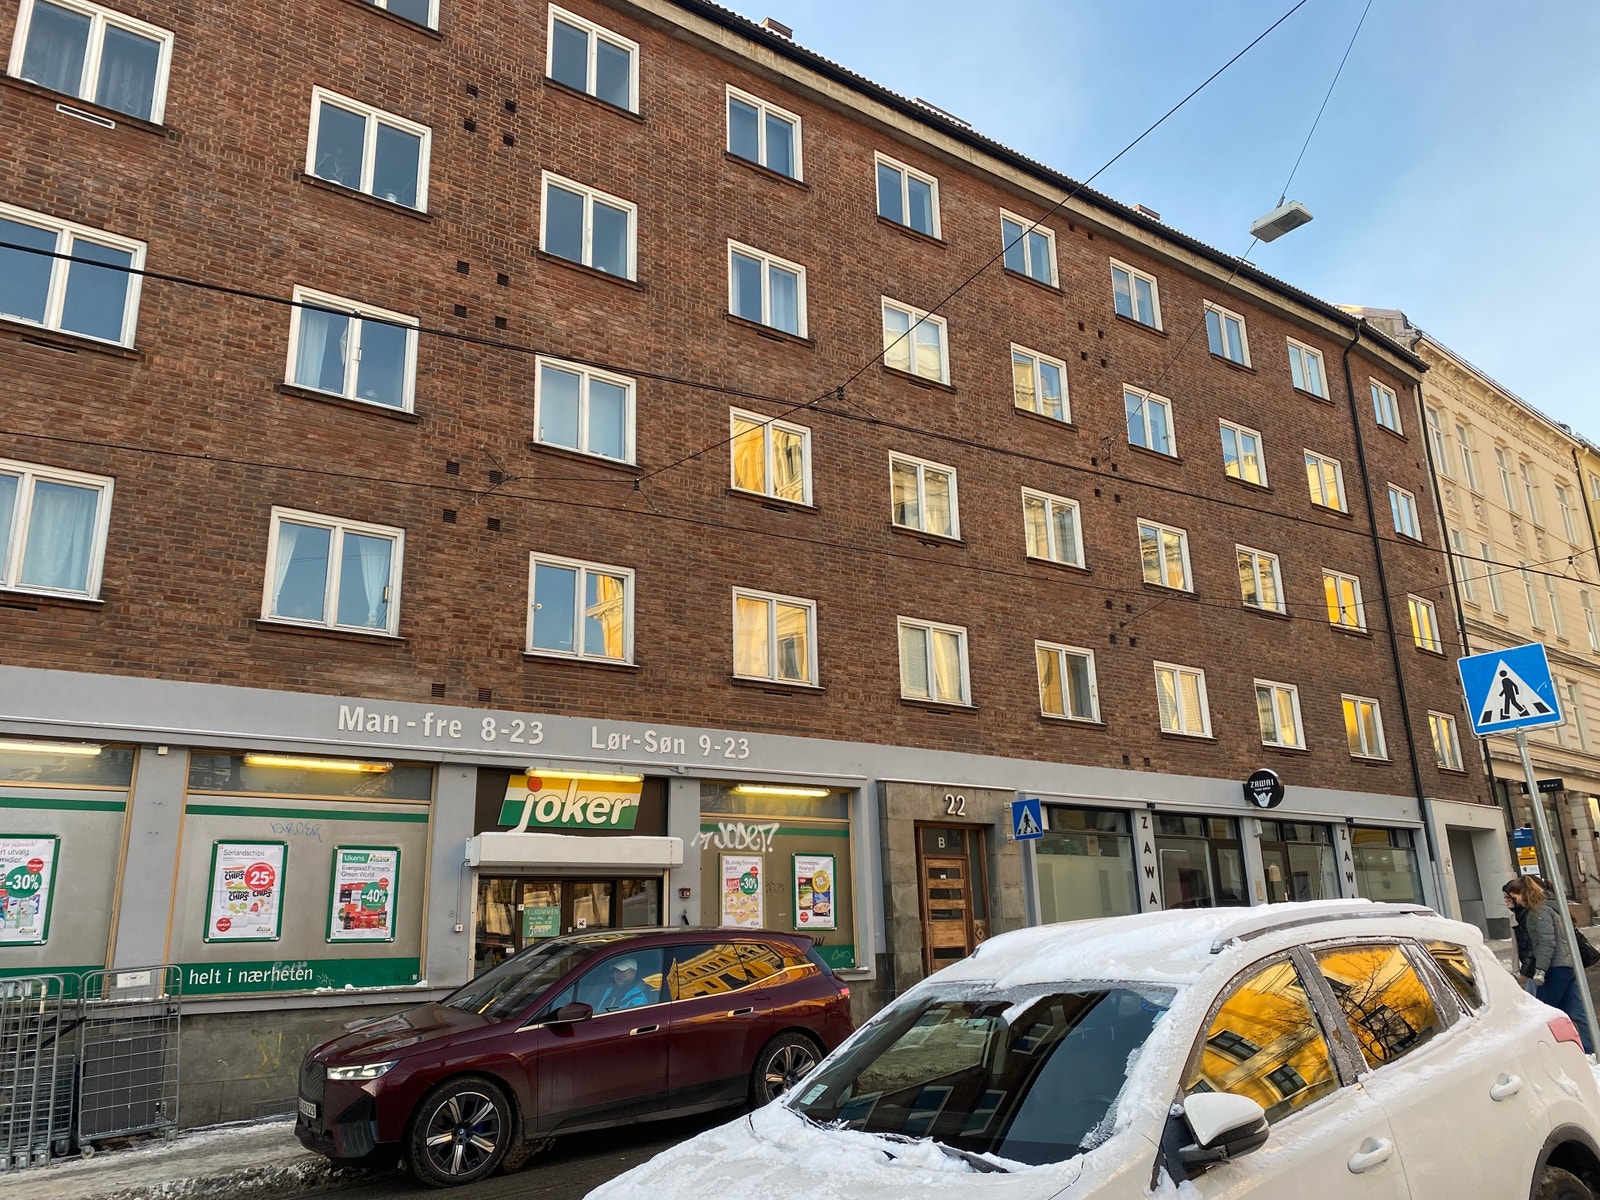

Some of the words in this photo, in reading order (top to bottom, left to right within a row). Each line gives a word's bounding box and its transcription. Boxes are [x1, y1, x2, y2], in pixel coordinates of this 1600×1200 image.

[480, 717, 544, 745] 8-23
[591, 726, 685, 755] Lør-Søn
[698, 734, 750, 760] 9-23
[507, 777, 632, 833] joker
[945, 793, 966, 817] 22
[938, 836, 946, 848] B
[223, 849, 265, 857] Sørlandschips
[344, 854, 365, 862] Ukens
[5, 874, 39, 890] -30%
[224, 872, 244, 880] CHIPS
[249, 871, 269, 885] 25
[228, 893, 249, 901] CHIPS
[361, 889, 386, 903] -40%
[189, 968, 222, 985] helt
[227, 968, 232, 983] i
[238, 966, 313, 984] nærheten
